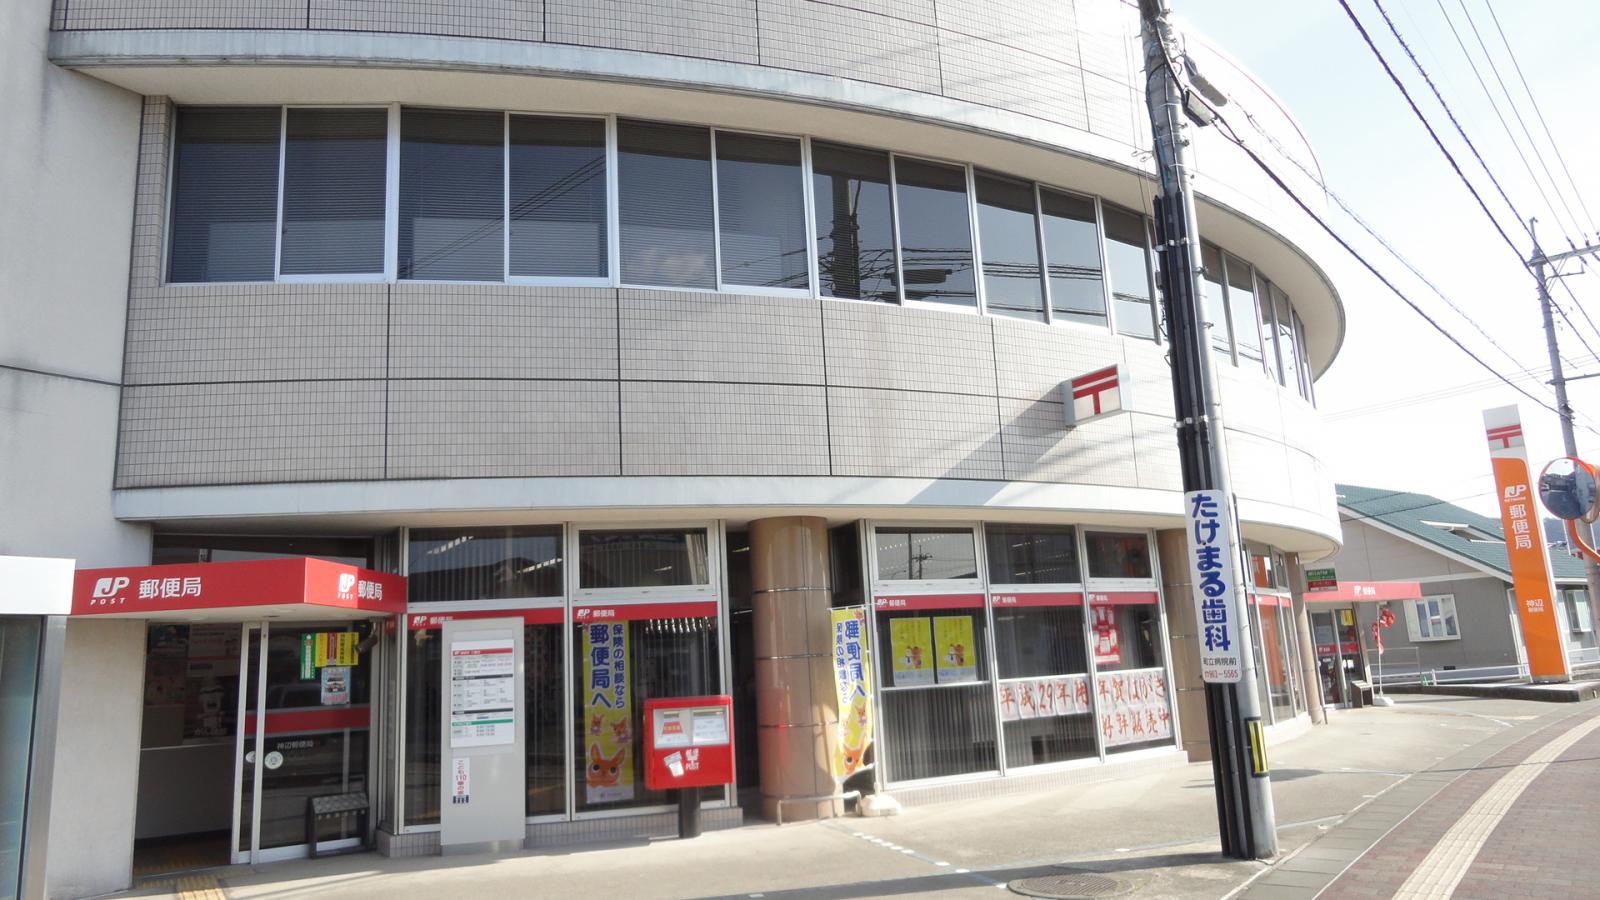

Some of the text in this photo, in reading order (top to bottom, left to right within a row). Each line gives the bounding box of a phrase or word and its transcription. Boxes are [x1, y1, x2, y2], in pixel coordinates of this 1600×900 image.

[1510, 504, 1532, 549] 郵便局
[138, 577, 202, 599] 郵便局
[1192, 493, 1231, 651] たけまる歯科
[358, 580, 383, 600] 郵便局
[590, 624, 611, 708] 郵便局へ
[612, 624, 625, 709] 保険の相談なら
[1000, 680, 1089, 713] 平成29年用
[1097, 674, 1166, 706] 年賀はがき
[1102, 707, 1170, 738] 好評販売中
